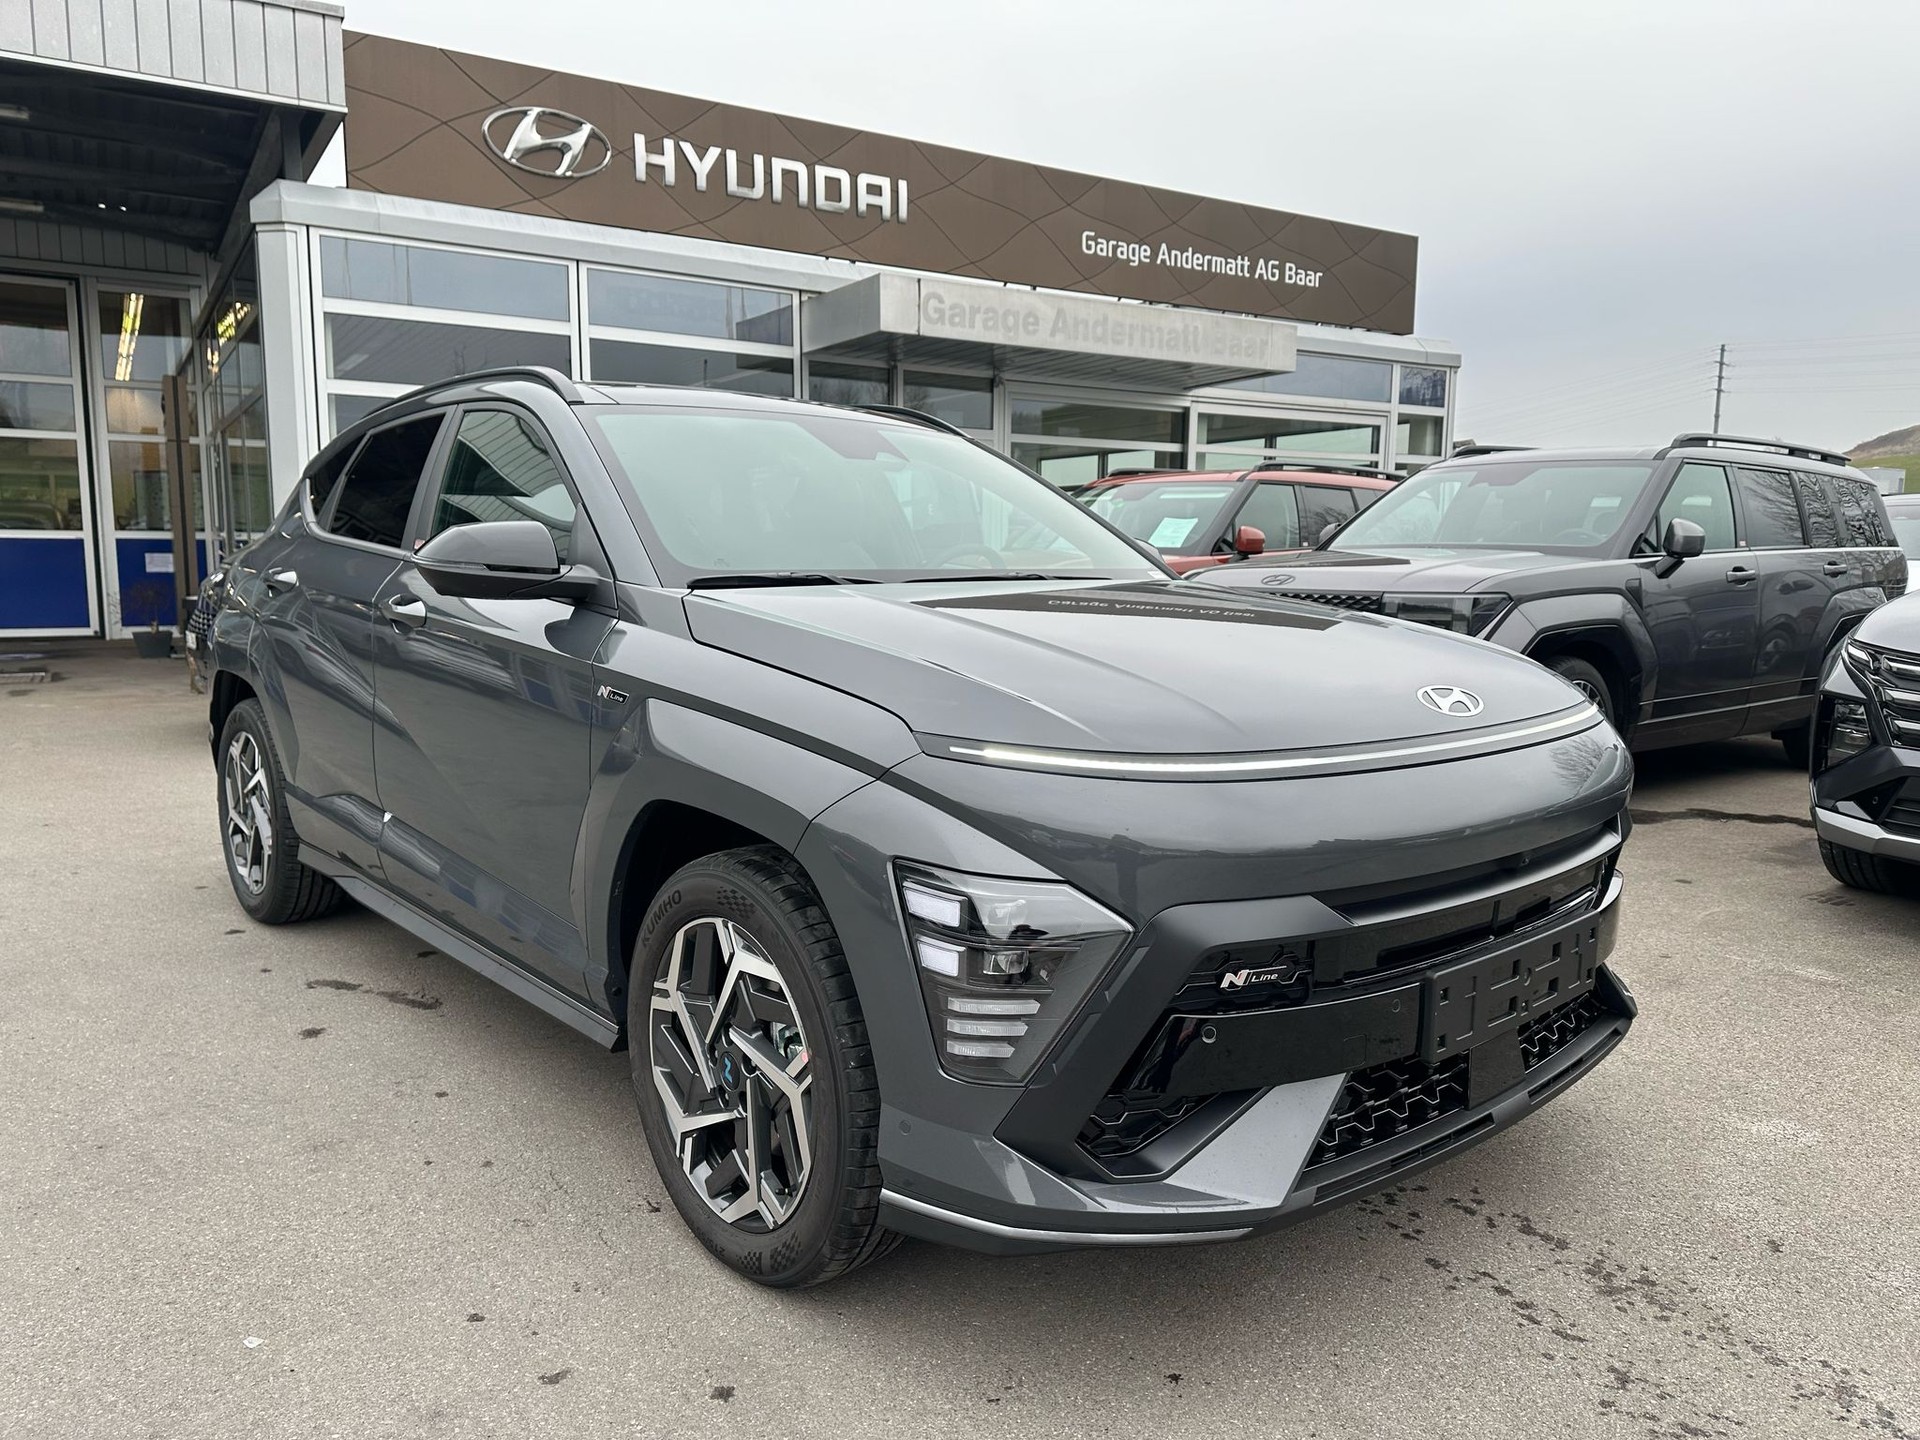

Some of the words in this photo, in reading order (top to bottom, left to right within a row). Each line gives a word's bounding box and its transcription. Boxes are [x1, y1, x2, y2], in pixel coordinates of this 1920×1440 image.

[633, 132, 908, 223] HYUNDAI
[1082, 231, 1151, 266] Garage
[1157, 243, 1250, 277] Andermatt
[1254, 258, 1280, 282] AG
[1284, 262, 1324, 288] Baar
[922, 291, 1040, 339] Garage
[1050, 306, 1201, 353] Andermatt
[597, 685, 611, 699] N
[642, 889, 682, 948] KUMHO
[1220, 969, 1249, 989] N
[1251, 973, 1279, 982] Line
